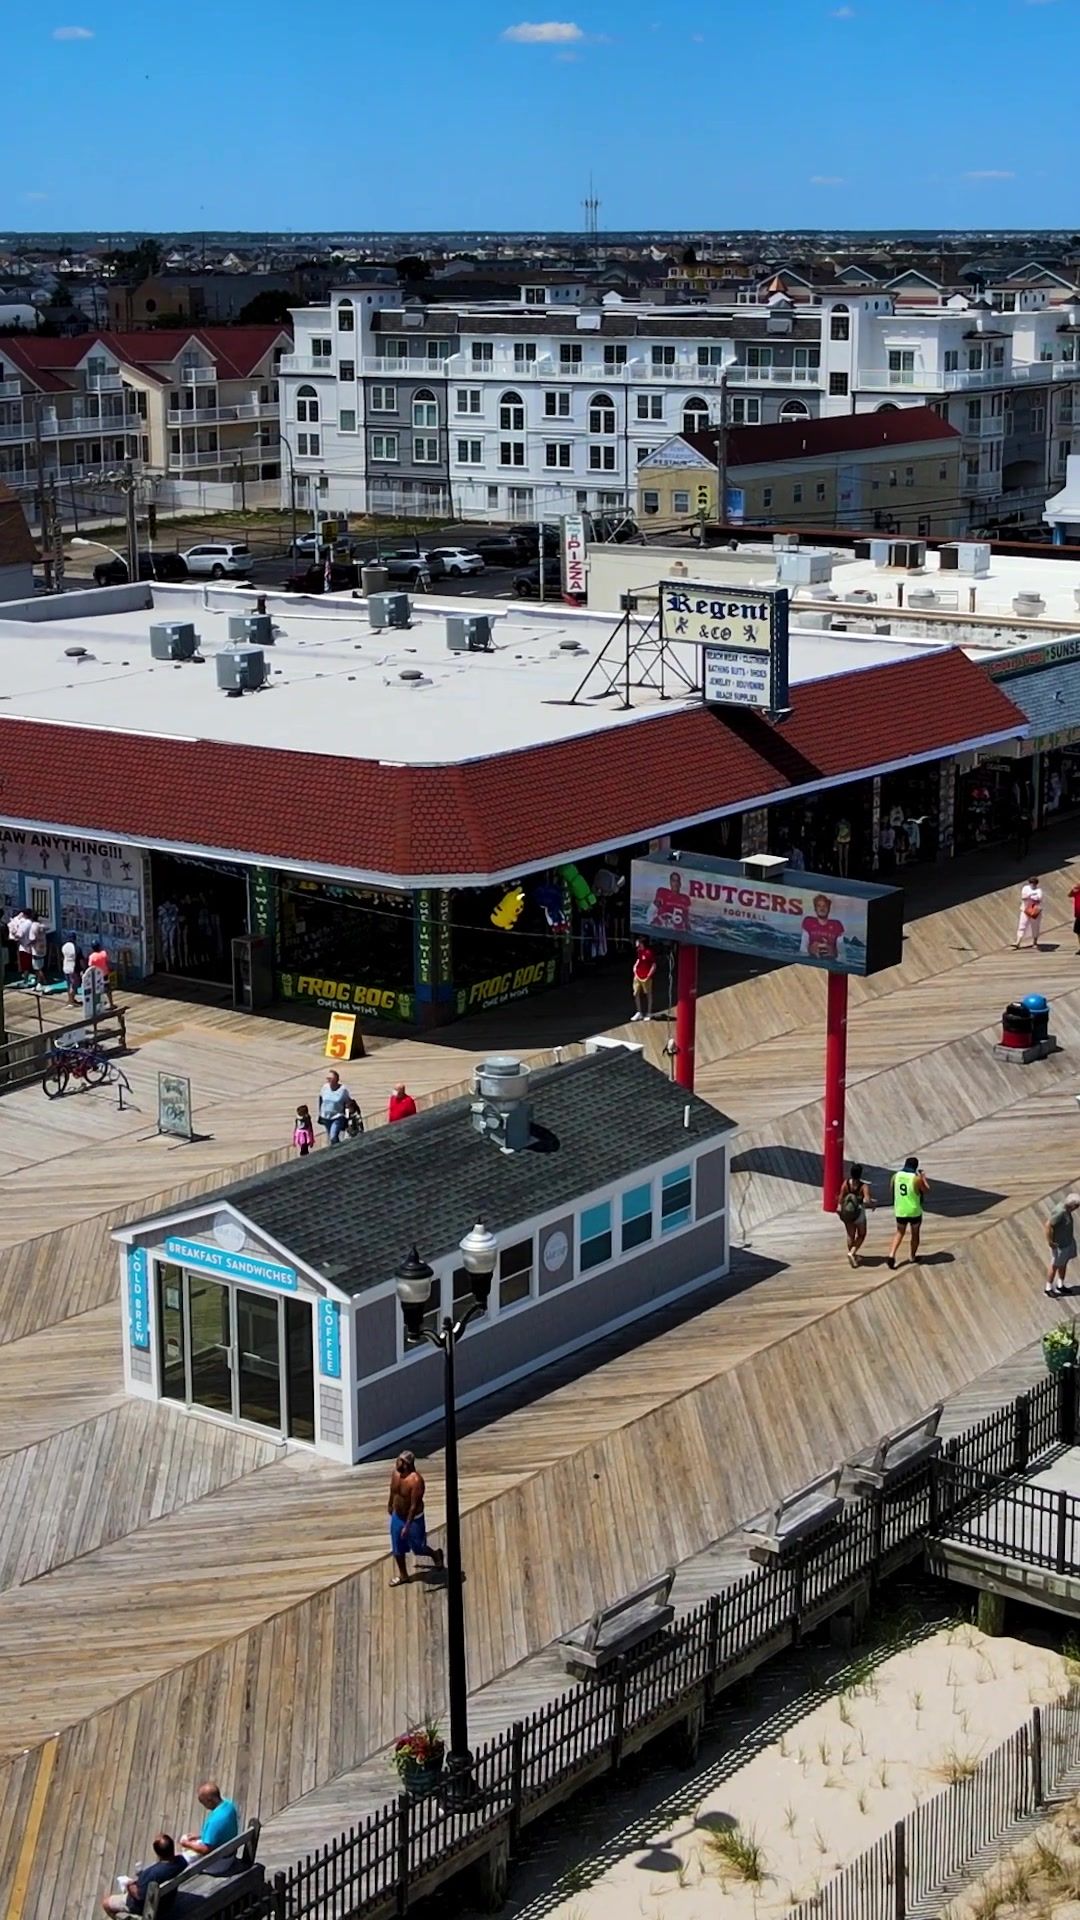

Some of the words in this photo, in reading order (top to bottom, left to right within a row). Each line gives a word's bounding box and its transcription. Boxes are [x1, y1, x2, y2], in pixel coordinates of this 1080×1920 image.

[567, 541, 583, 590] PIZZA
[666, 592, 768, 620] Regent
[699, 624, 731, 641] &CO
[31, 834, 122, 859] ANYTHING!!!
[689, 879, 803, 916] RUTGERS
[723, 907, 768, 922] FOOTBALL
[297, 976, 350, 1001] FROG
[353, 985, 396, 1009] BOG
[469, 972, 513, 1005] FROG
[513, 961, 545, 989] BOG
[317, 998, 338, 1010] ONE
[351, 1004, 378, 1017] WINS
[900, 1183, 908, 1196] 9
[132, 1249, 143, 1293] COLD
[168, 1241, 223, 1266] BREAKFAST
[226, 1257, 294, 1286] SANDWICHES
[135, 1299, 146, 1342] BREW
[324, 1304, 335, 1372] COFFEE
